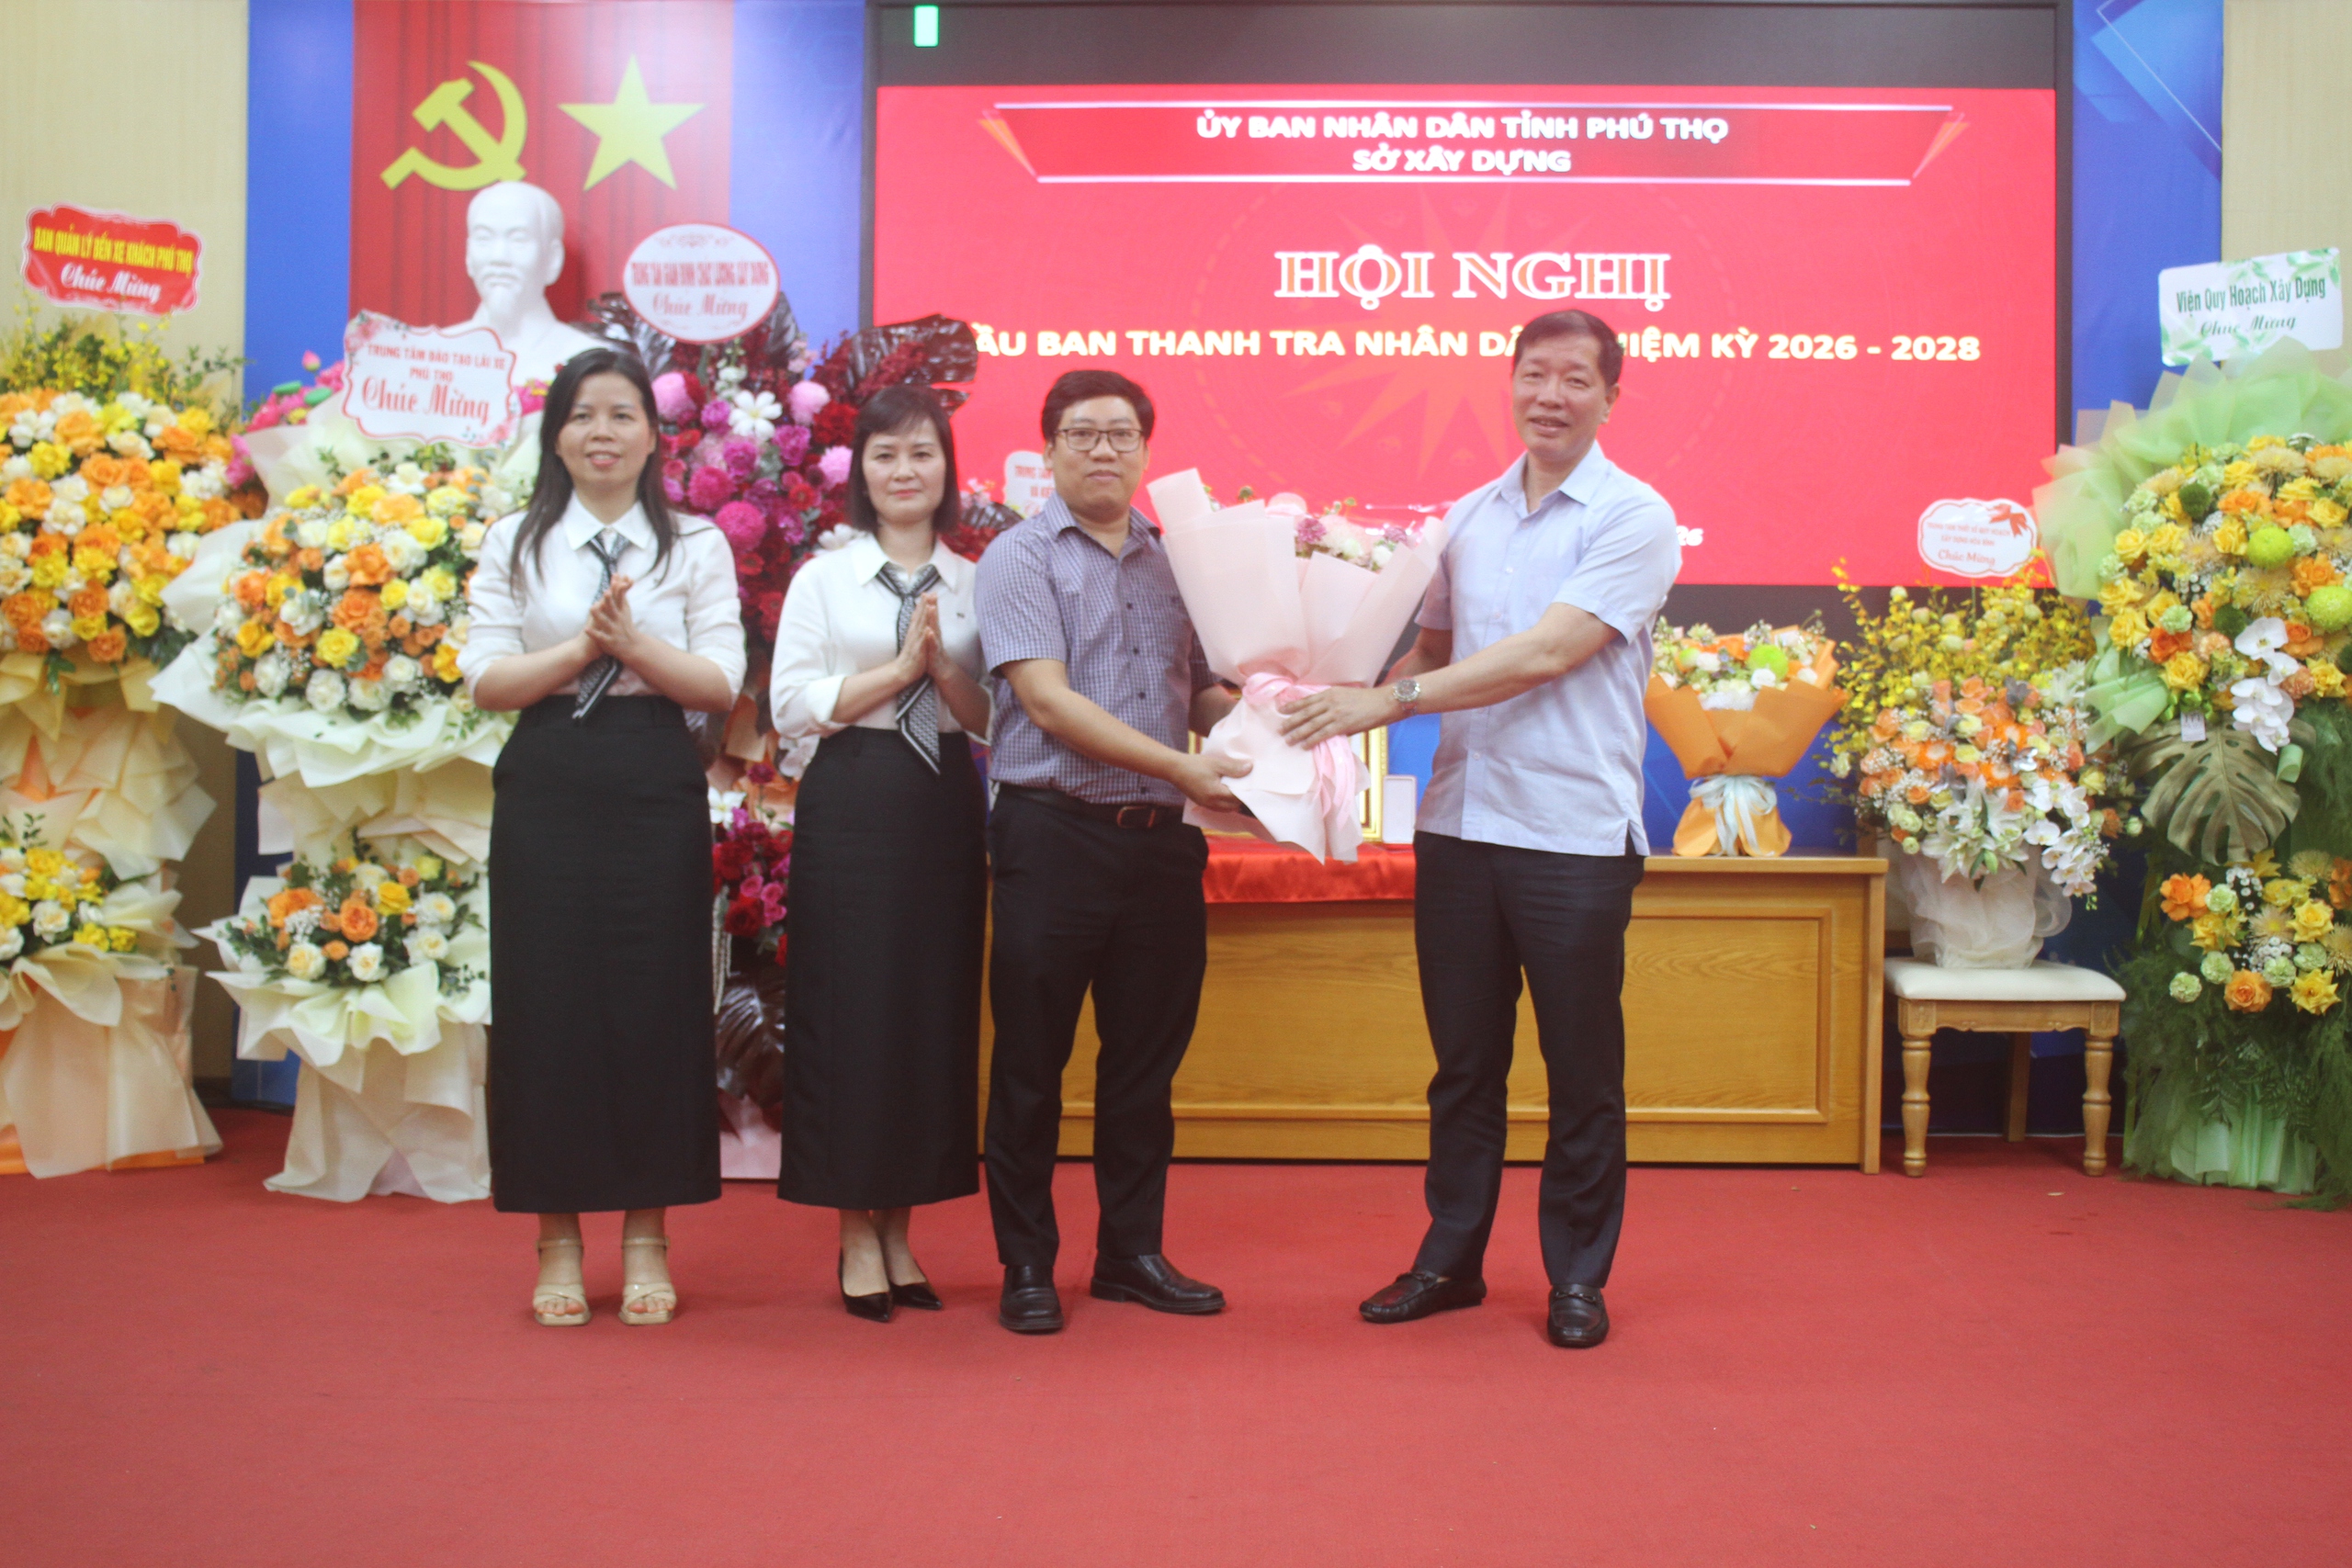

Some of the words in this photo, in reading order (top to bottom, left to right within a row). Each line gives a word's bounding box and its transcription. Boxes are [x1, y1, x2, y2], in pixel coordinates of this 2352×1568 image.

[1196, 108, 1242, 138] ỦY
[1249, 116, 1316, 138] BAN
[1323, 111, 1418, 138] NHÂN
[1425, 111, 1495, 138] DÂN
[1500, 109, 1578, 139] TỈNH
[1587, 112, 1654, 140] PHÚ
[1659, 118, 1729, 144] THỌ
[1352, 141, 1402, 172] SỞ
[1403, 144, 1465, 172] XÂY
[1472, 148, 1571, 176] DỰNG
[33, 226, 54, 252] BAN
[112, 240, 126, 264] XE
[156, 243, 175, 271] PHÚ
[175, 249, 194, 278] THỌ
[61, 262, 107, 291] Chúc
[107, 270, 161, 304] Mừng
[1273, 243, 1435, 311] HỘI
[1452, 251, 1671, 312] NGHỊ
[2177, 290, 2200, 317] Viện
[2205, 288, 2225, 310] Quy
[2230, 282, 2267, 310] Hoạch
[2270, 278, 2291, 303] Xây
[368, 344, 401, 359] TRUNG
[404, 347, 425, 360] TÂM
[971, 321, 1027, 356] ẦU
[1037, 331, 1117, 356] BAN
[1125, 331, 1261, 356] THANH
[1270, 331, 1346, 356] TRA
[1354, 324, 1468, 357] NHÂN
[1711, 326, 1758, 359] KỲ
[1768, 333, 1859, 361] 2026
[1891, 334, 1981, 361] 2028
[362, 376, 418, 412] Chúc
[424, 384, 490, 426] Mừng
